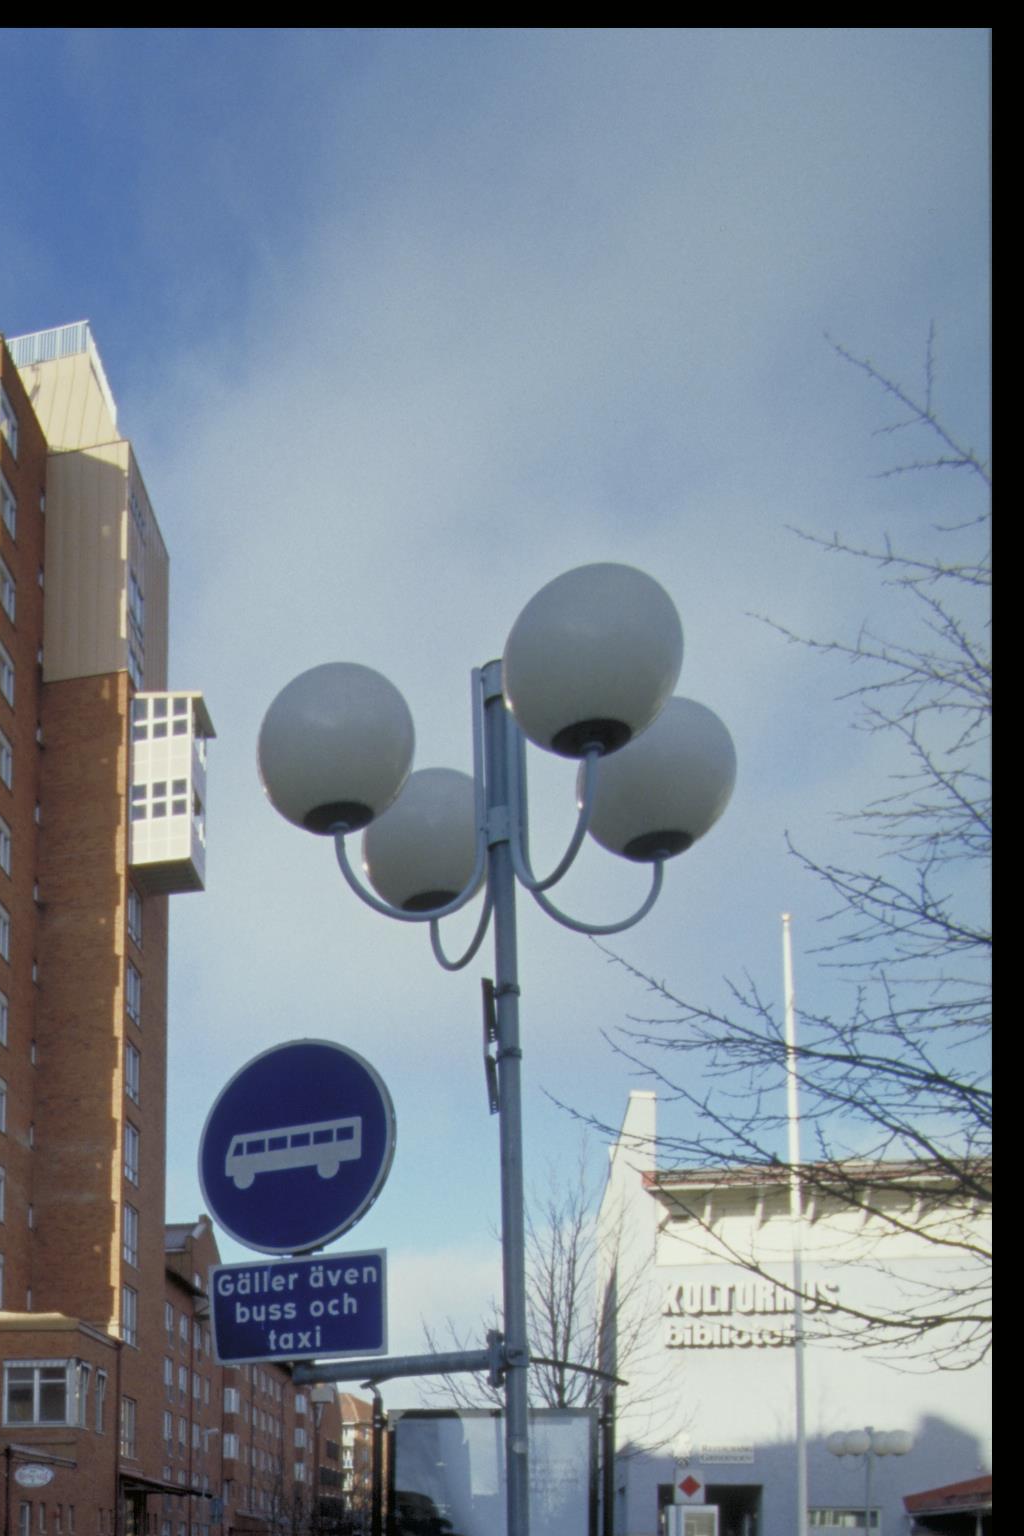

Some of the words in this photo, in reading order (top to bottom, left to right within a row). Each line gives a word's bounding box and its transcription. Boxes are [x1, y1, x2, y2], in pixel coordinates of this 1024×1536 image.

[217, 1271, 299, 1297] Gäller
[309, 1265, 377, 1289] även
[236, 1301, 297, 1324] buss
[309, 1293, 358, 1318] och
[662, 1280, 840, 1317] KULTURHUS
[268, 1325, 322, 1351] taxi
